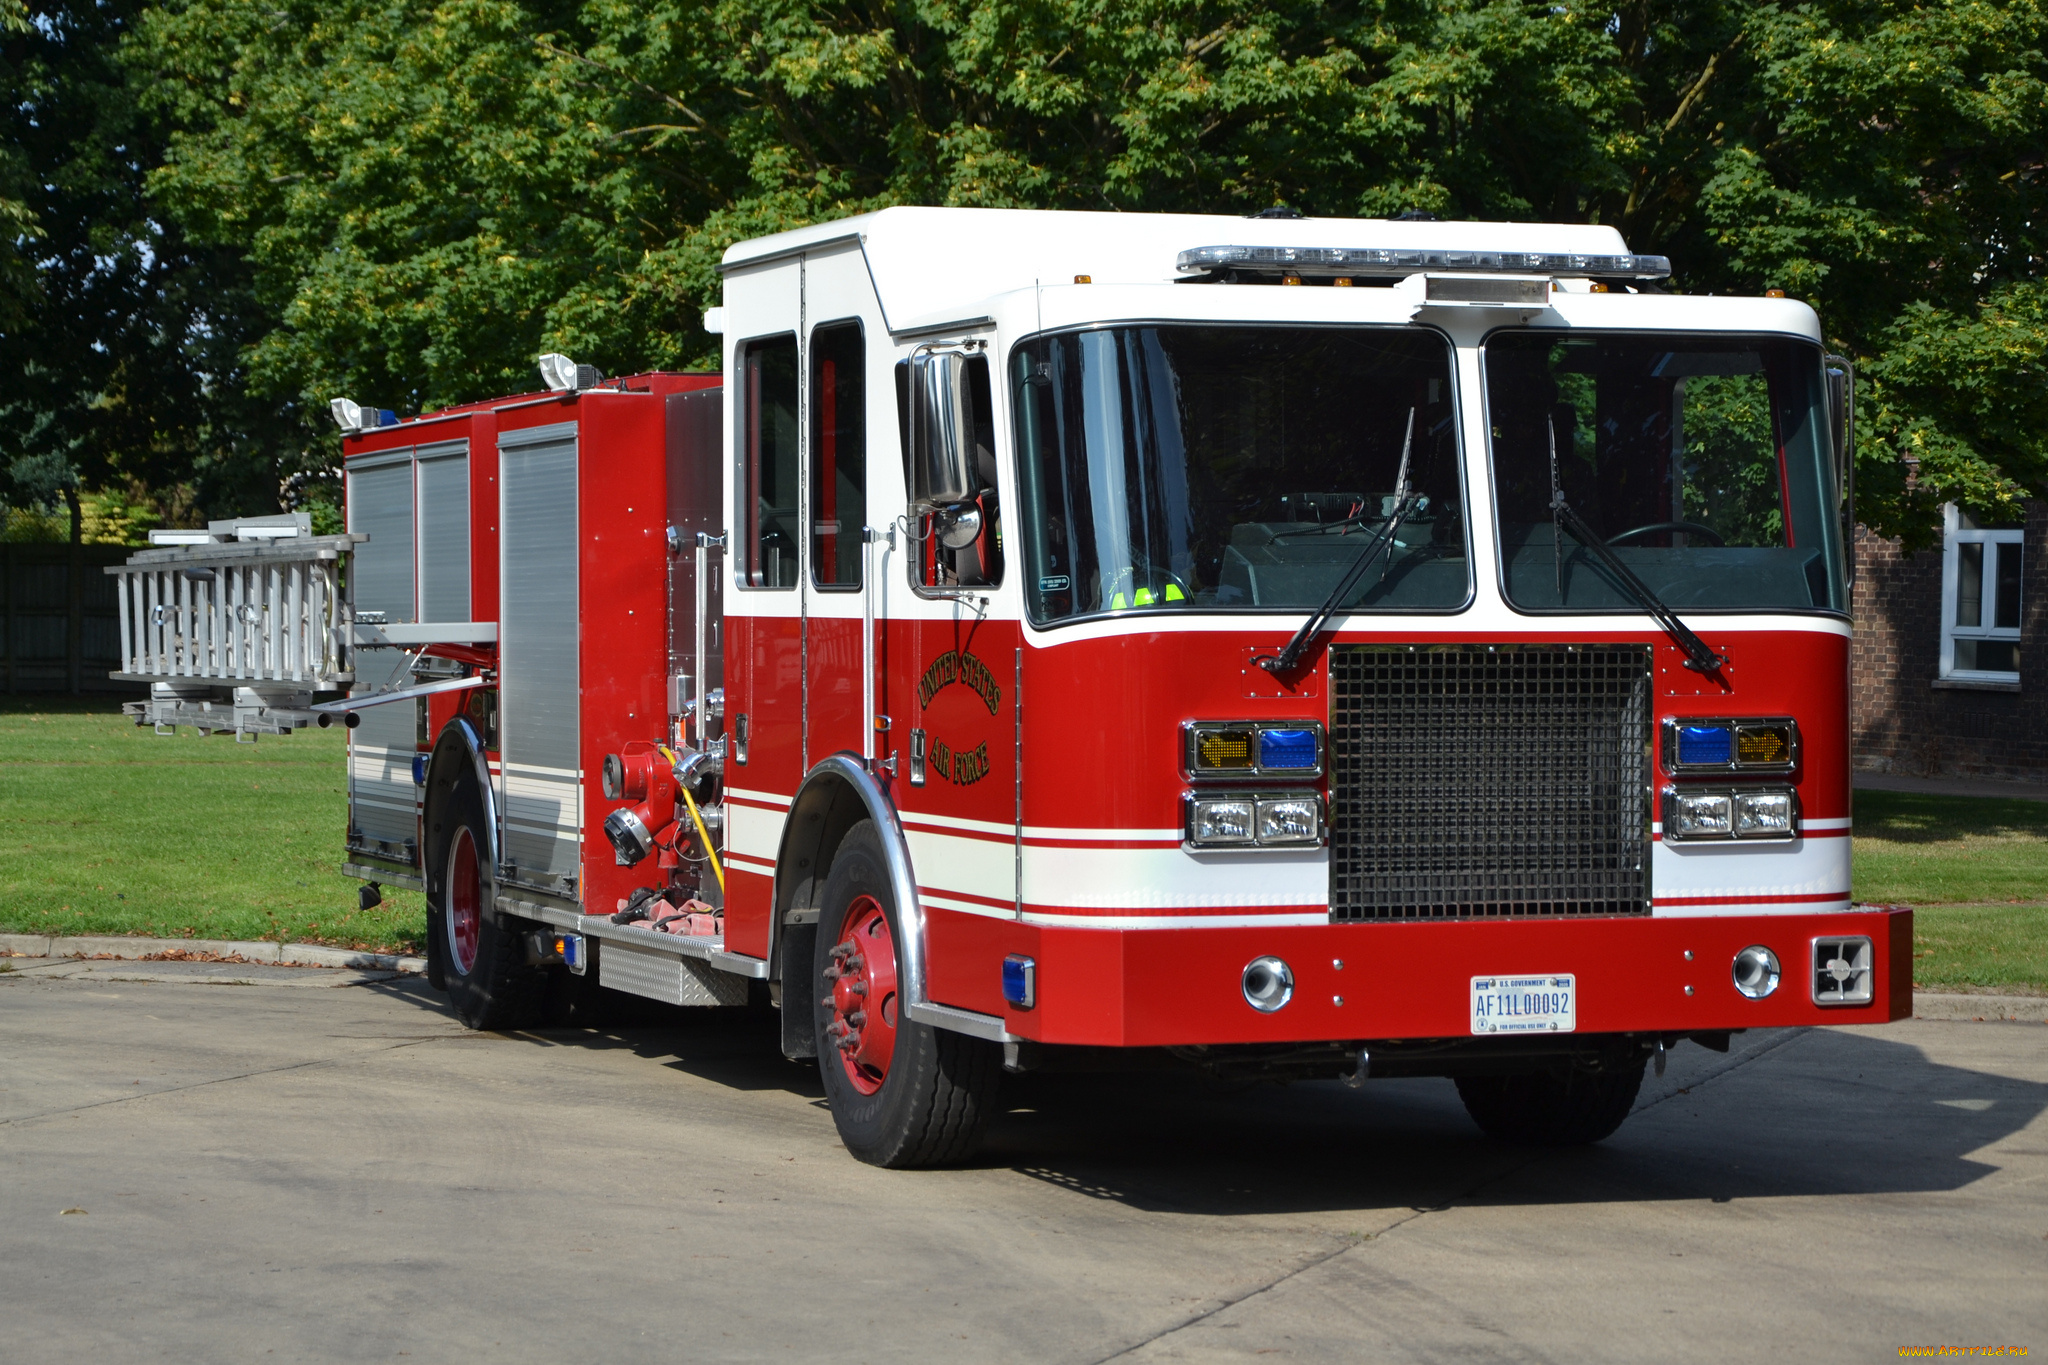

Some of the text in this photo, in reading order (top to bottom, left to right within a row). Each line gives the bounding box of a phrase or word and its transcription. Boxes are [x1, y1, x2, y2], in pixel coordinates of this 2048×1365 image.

[917, 649, 1001, 716] UNITED STATES
[929, 736, 990, 786] AIR FORCE
[1511, 979, 1546, 987] GOVERNMENT
[1476, 992, 1569, 1016] AF11L00092
